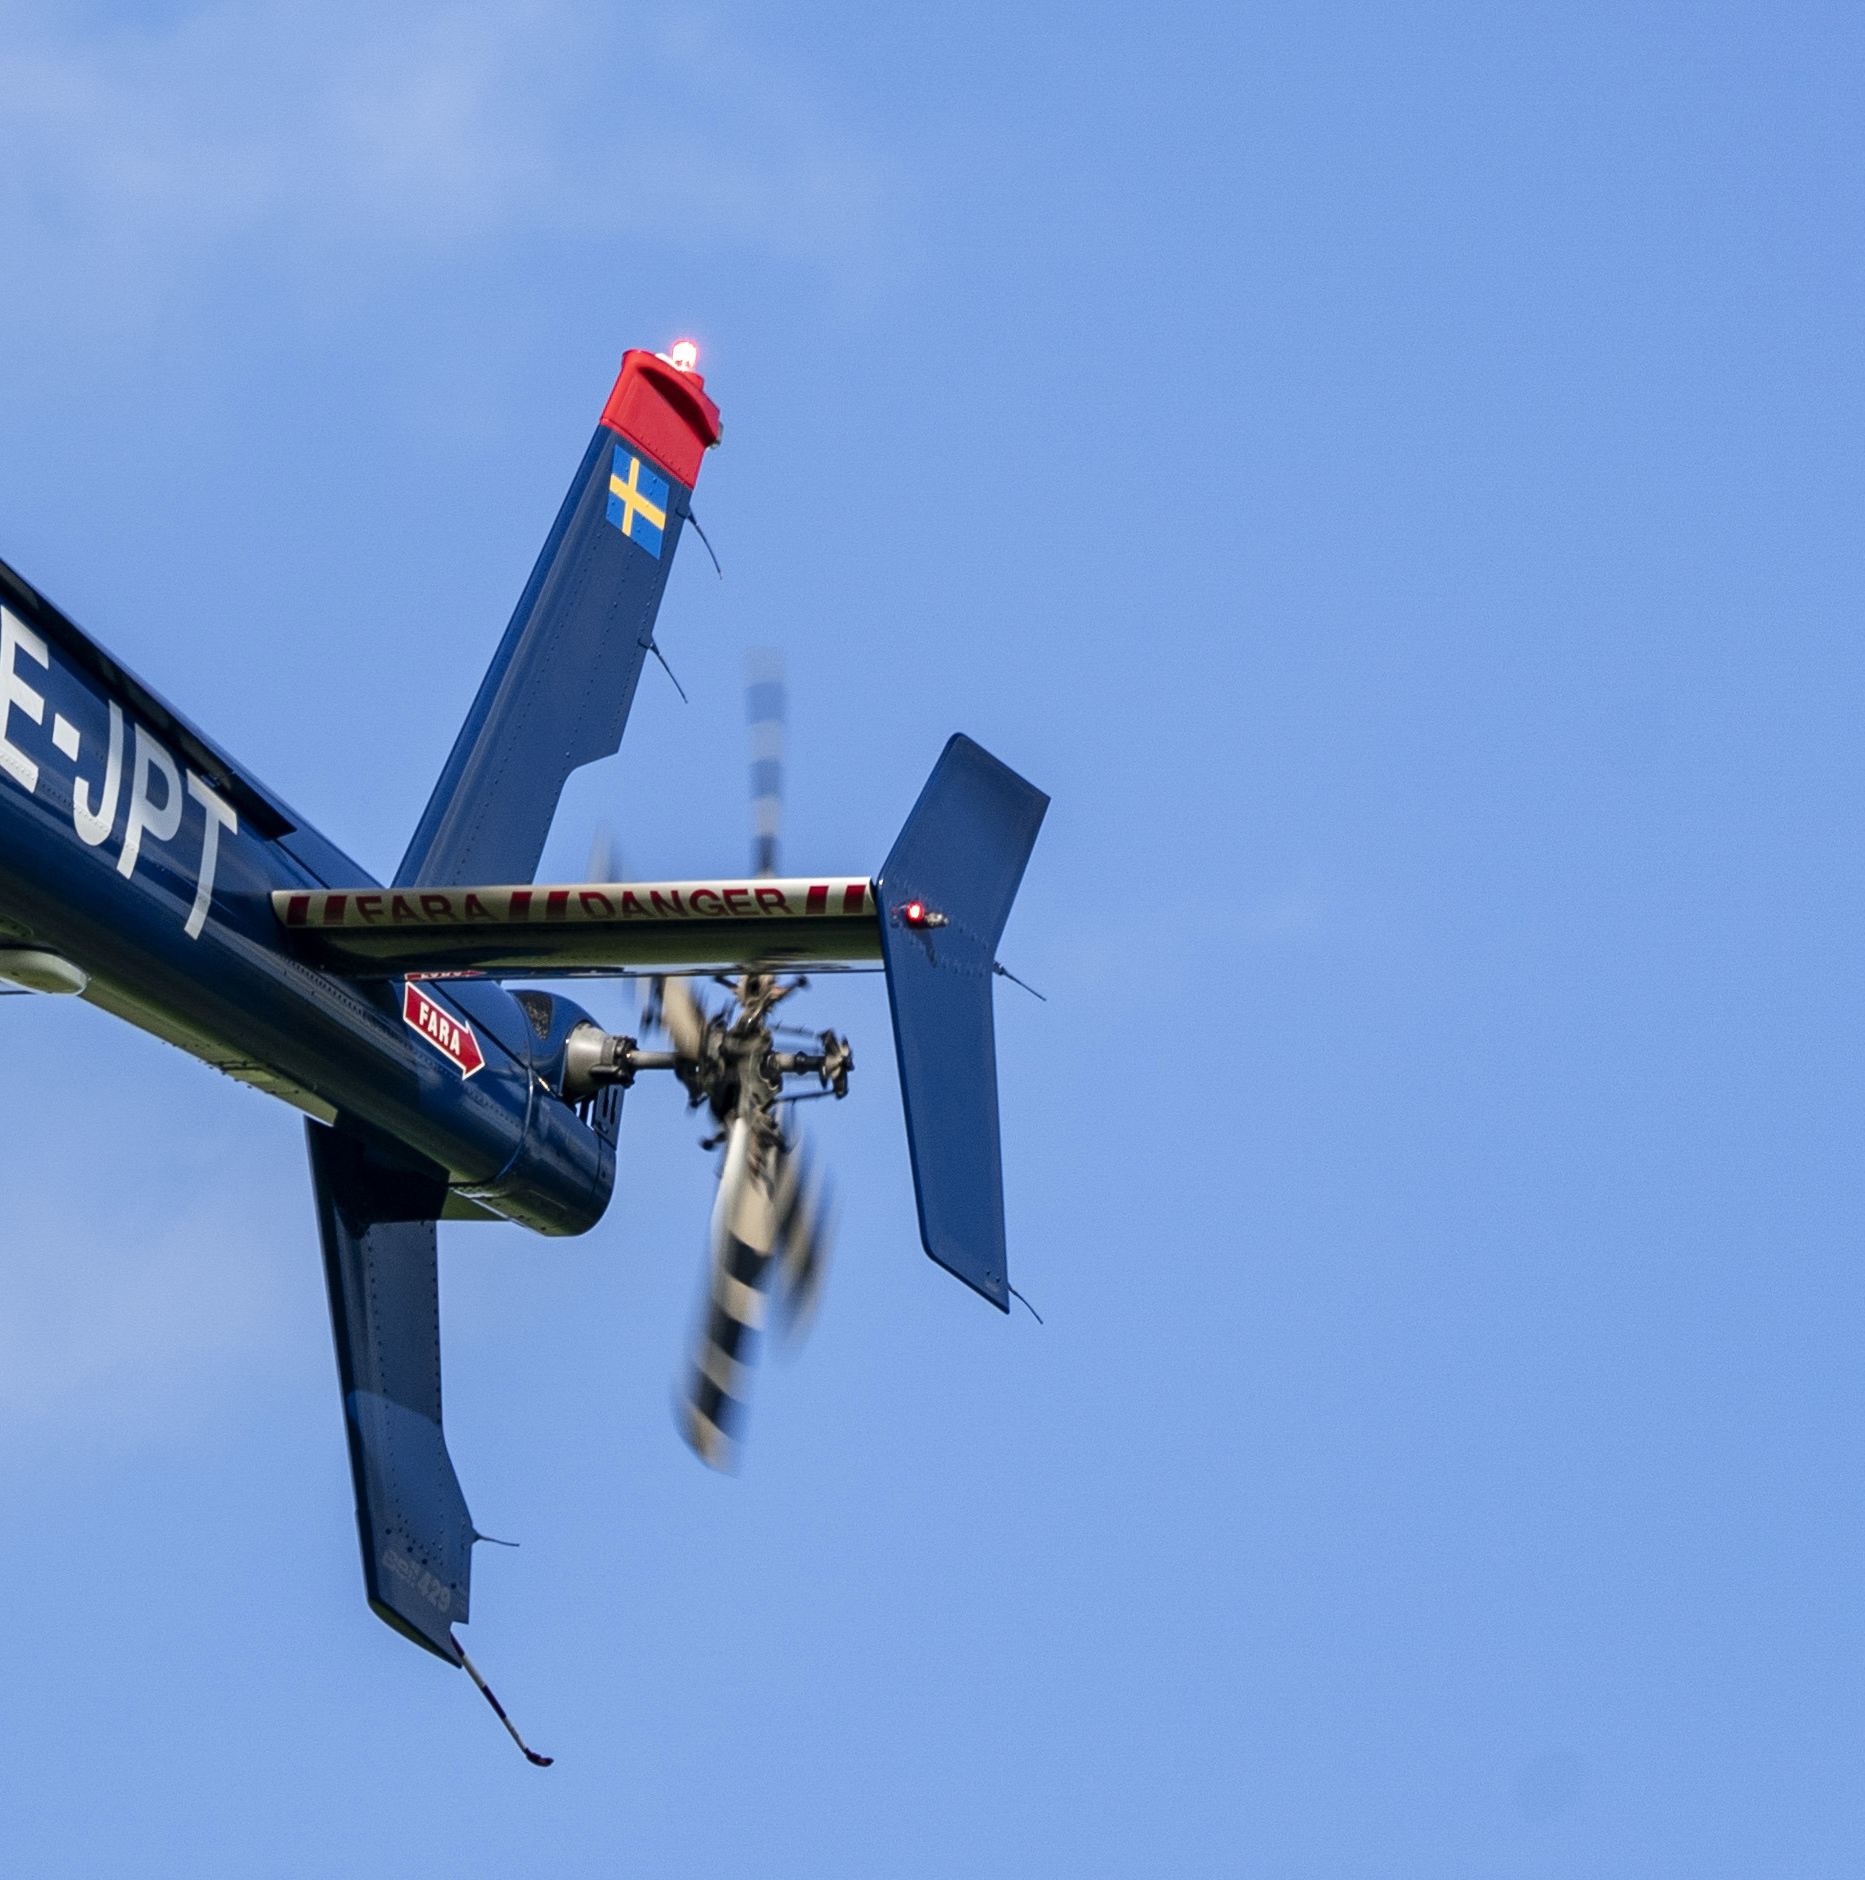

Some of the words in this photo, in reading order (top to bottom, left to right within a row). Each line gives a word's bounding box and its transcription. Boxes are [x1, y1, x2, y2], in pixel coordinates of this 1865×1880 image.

[355, 893, 497, 925] FARA
[578, 887, 795, 920] DANGER
[419, 1001, 461, 1056] FARA
